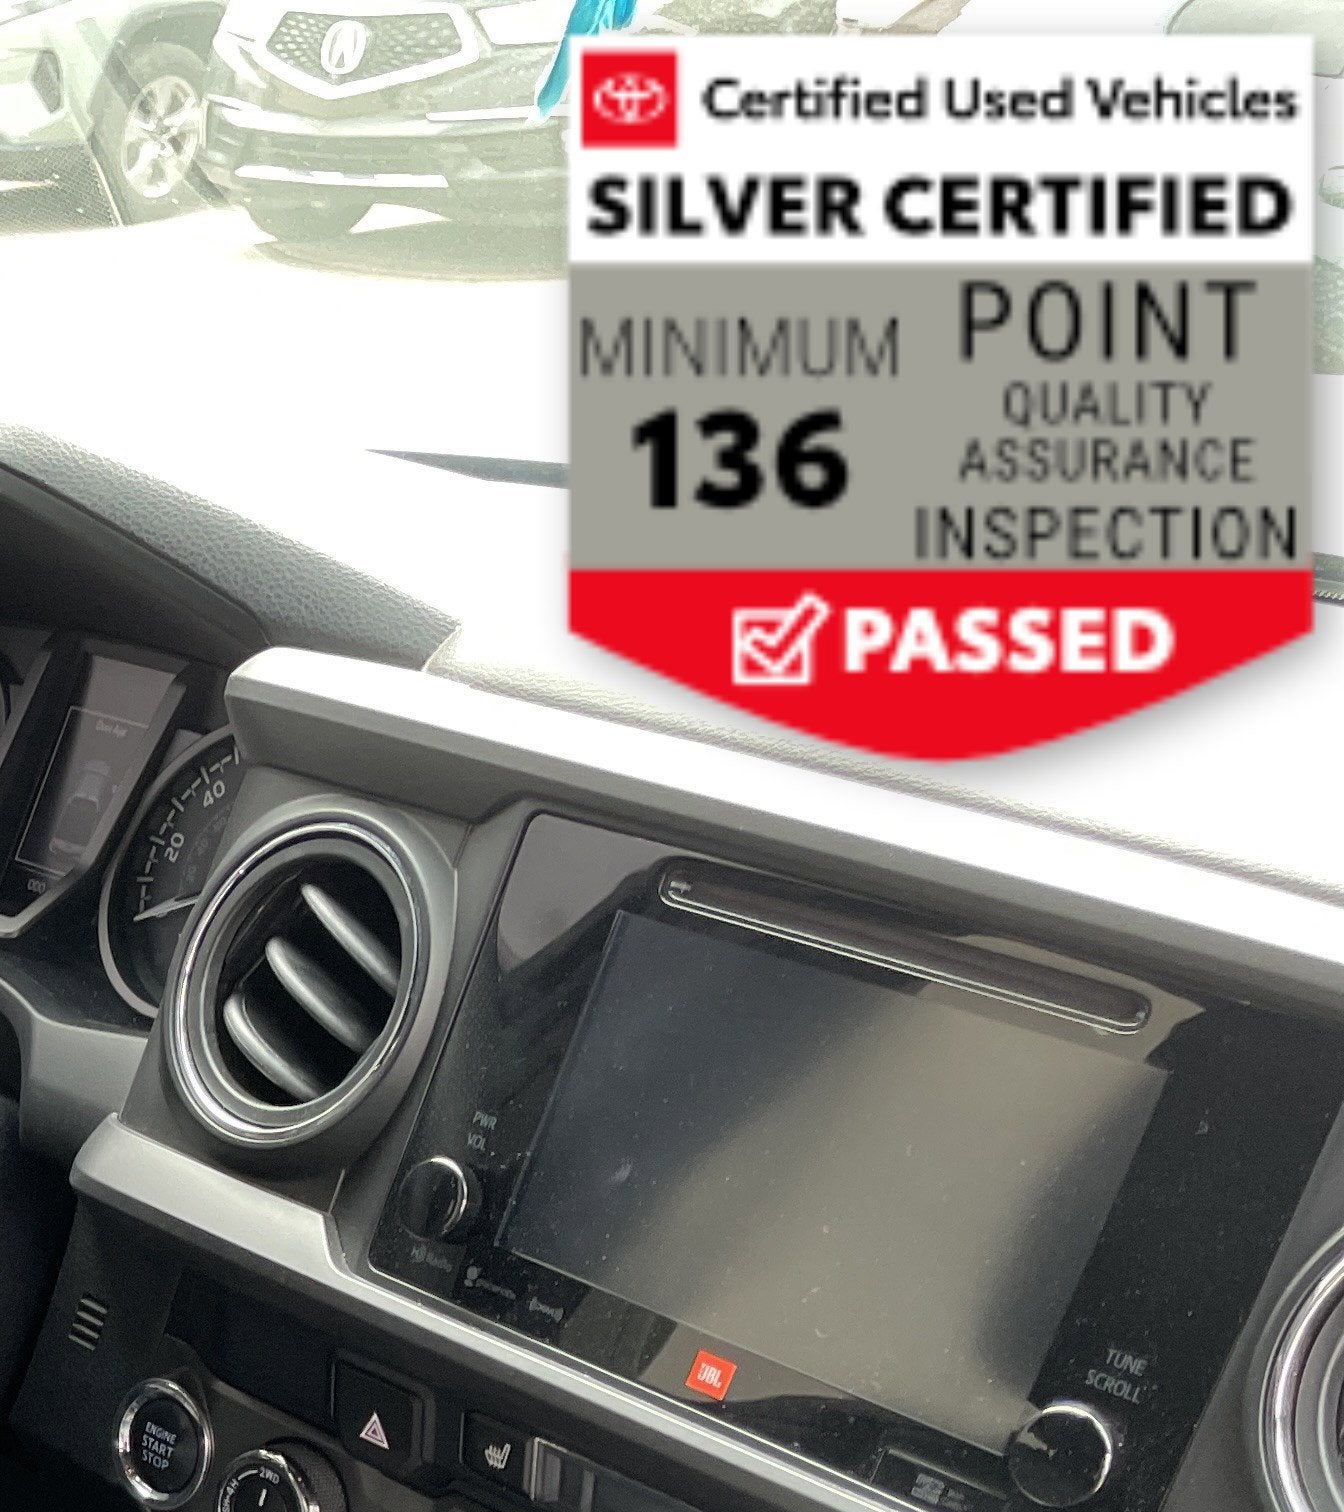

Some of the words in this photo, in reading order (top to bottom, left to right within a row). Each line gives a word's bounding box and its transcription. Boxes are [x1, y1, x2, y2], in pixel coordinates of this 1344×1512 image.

[202, 779, 226, 808] 40
[164, 832, 185, 864] 20
[472, 1111, 497, 1130] PWR
[467, 1132, 486, 1151] VOL
[1105, 1347, 1147, 1377] TUNE
[697, 1362, 722, 1389] JBL
[1085, 1367, 1140, 1405] SCROLL
[145, 1421, 177, 1443] ENGINE
[141, 1435, 175, 1457] START
[142, 1449, 170, 1470] STOP
[259, 1466, 281, 1485] 2WD
